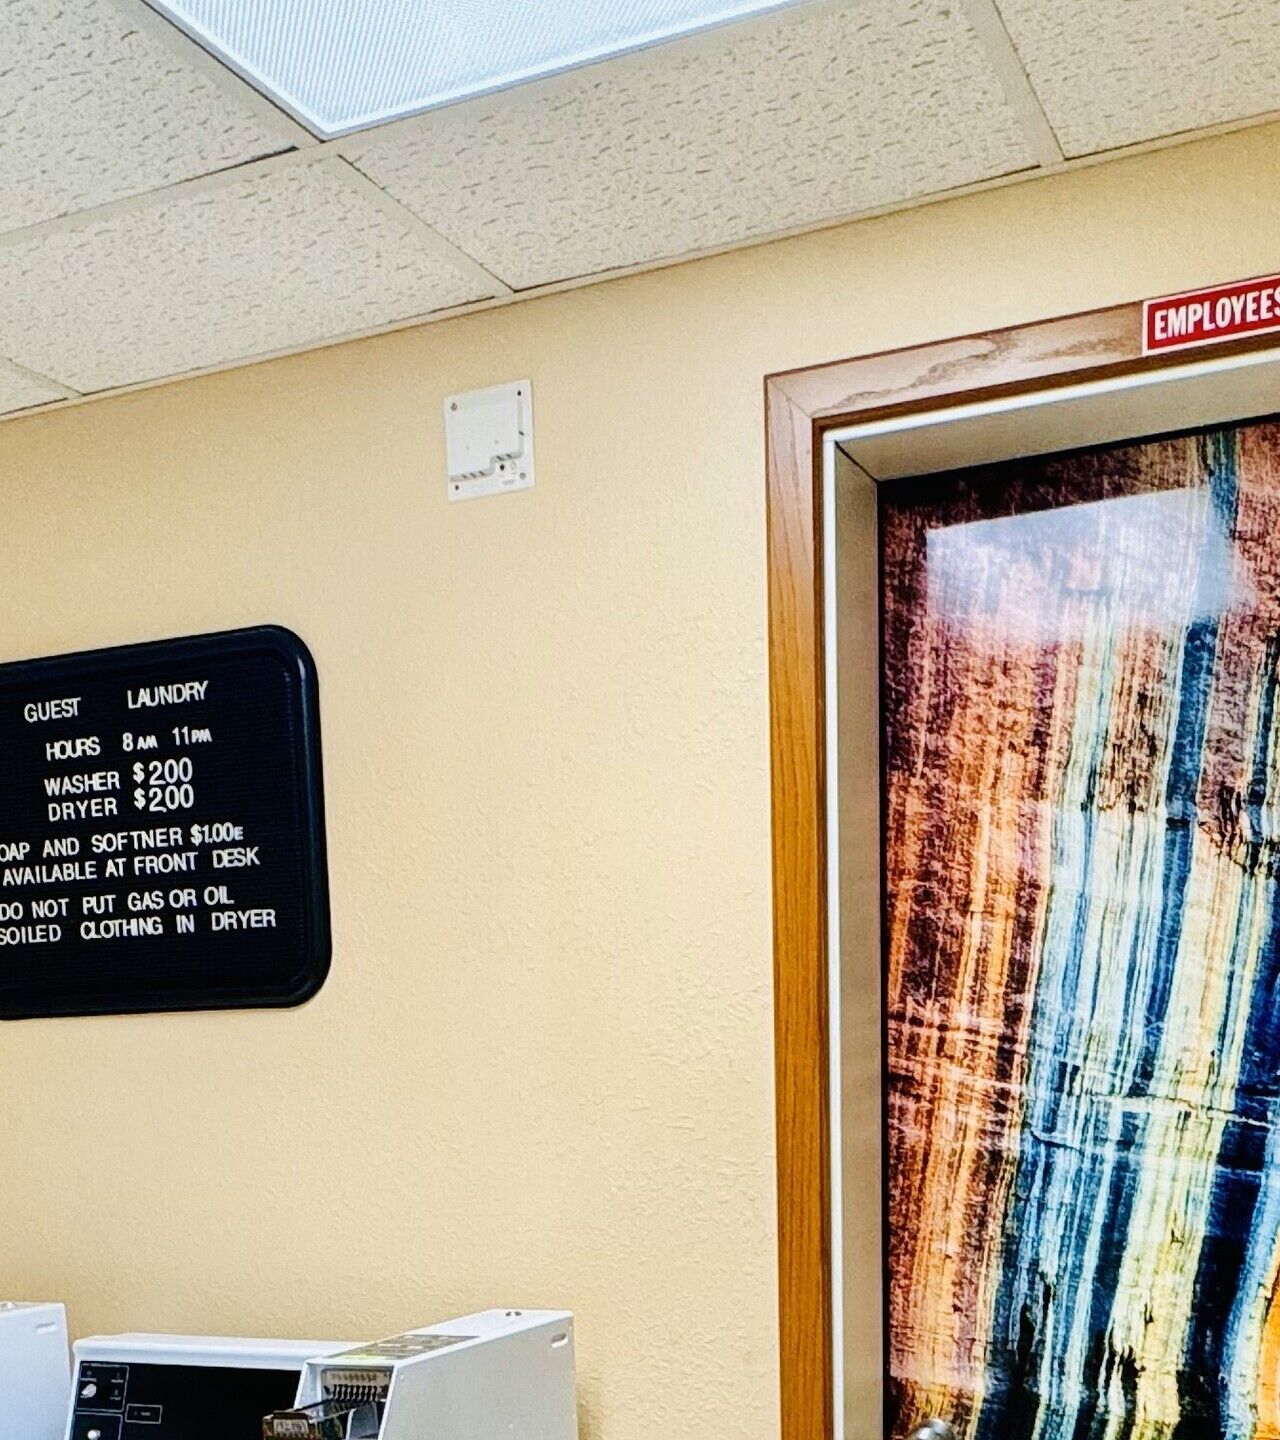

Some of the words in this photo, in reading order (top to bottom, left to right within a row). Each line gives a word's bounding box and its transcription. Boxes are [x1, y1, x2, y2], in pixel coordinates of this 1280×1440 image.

[23, 696, 82, 724] GUEST
[126, 679, 209, 710] LAUNDRY
[45, 735, 101, 762] HOURS
[43, 770, 121, 797] WASHER
[47, 796, 118, 823] DRYER
[42, 836, 80, 859] AND
[90, 827, 184, 856] SOFTNER
[2, 860, 98, 887] AVAILABLE
[105, 857, 127, 878] AT
[133, 851, 199, 876] FRONT
[211, 846, 261, 869] DESK
[31, 897, 70, 919] NOT
[82, 894, 117, 915] PUT
[127, 890, 165, 912] GAS
[168, 888, 198, 909] OR
[203, 885, 235, 906] OIL
[79, 915, 164, 941] CLOTHING
[175, 913, 195, 934] IN
[211, 908, 277, 931] DRYER
